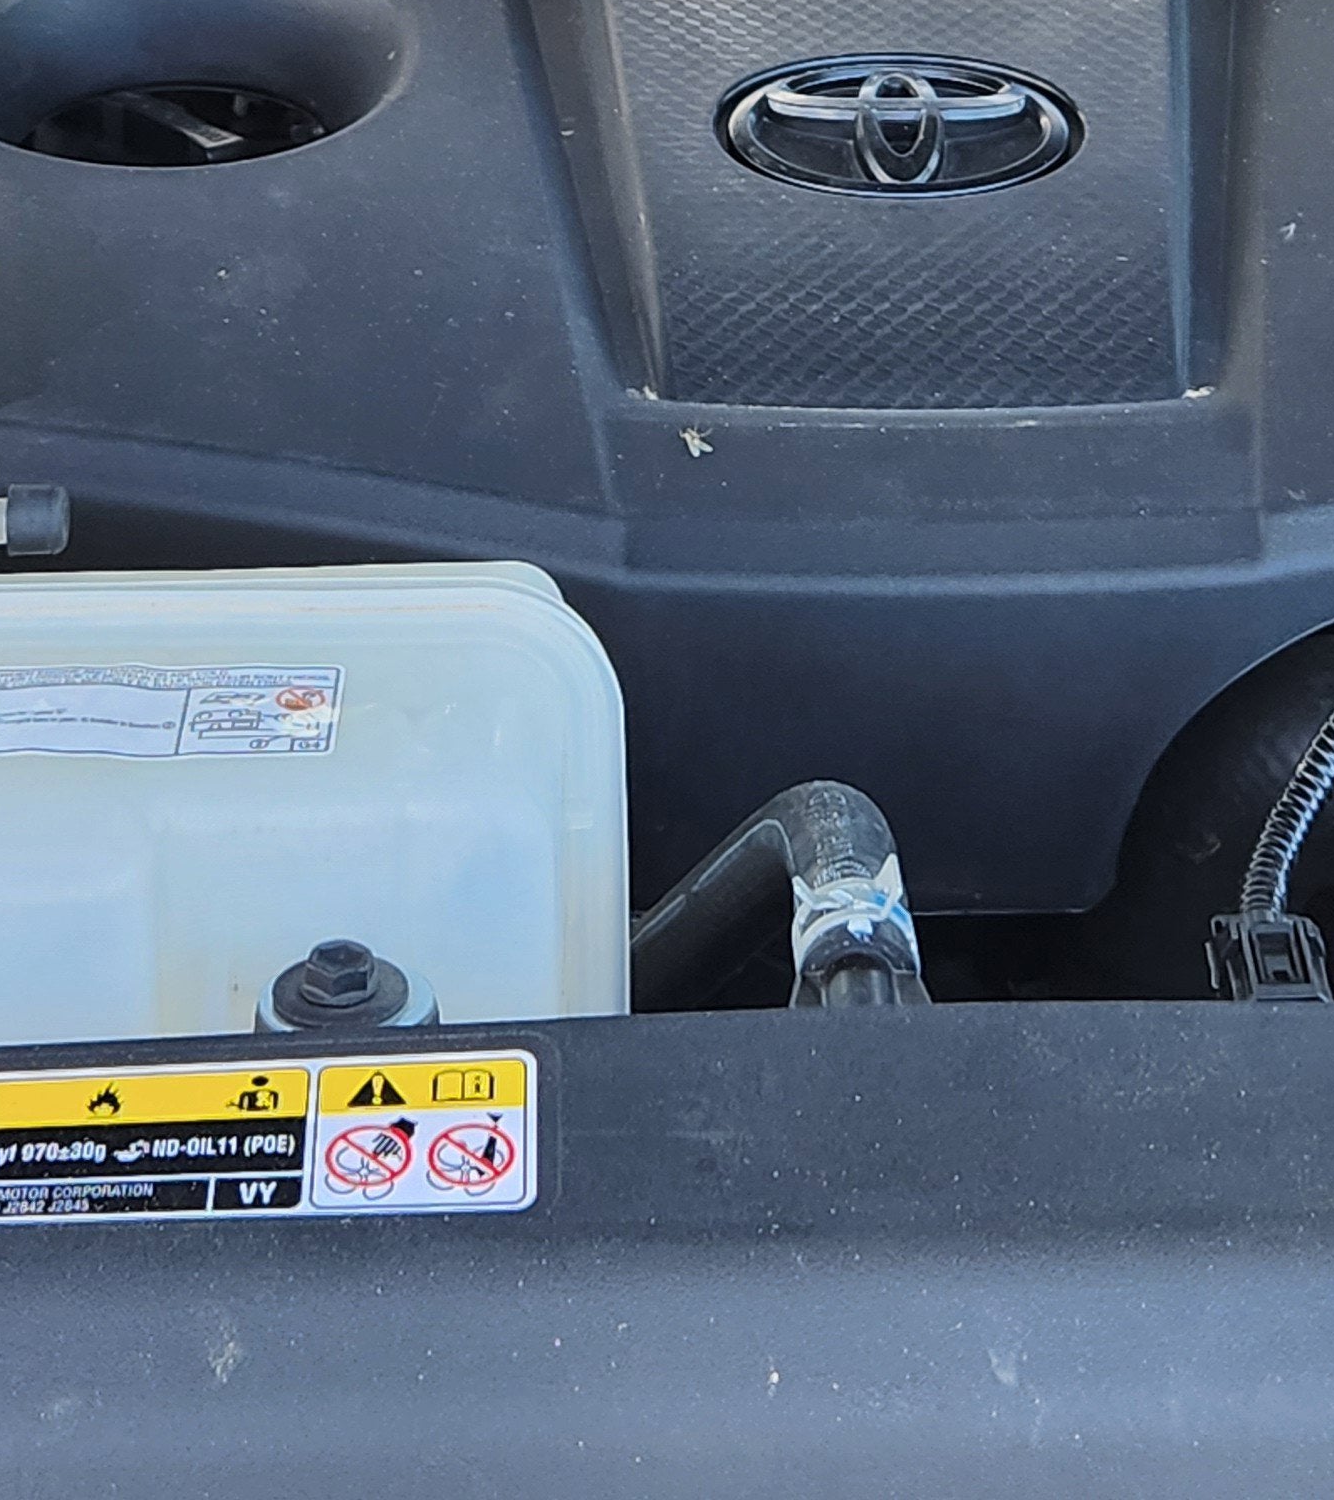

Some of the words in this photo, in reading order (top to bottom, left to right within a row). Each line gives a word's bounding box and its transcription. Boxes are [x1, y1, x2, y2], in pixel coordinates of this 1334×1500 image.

[151, 1135, 238, 1158] ND-OIL11
[243, 1133, 296, 1158] (POE)
[51, 1183, 154, 1200] CORPORATION
[238, 1181, 278, 1205] VY
